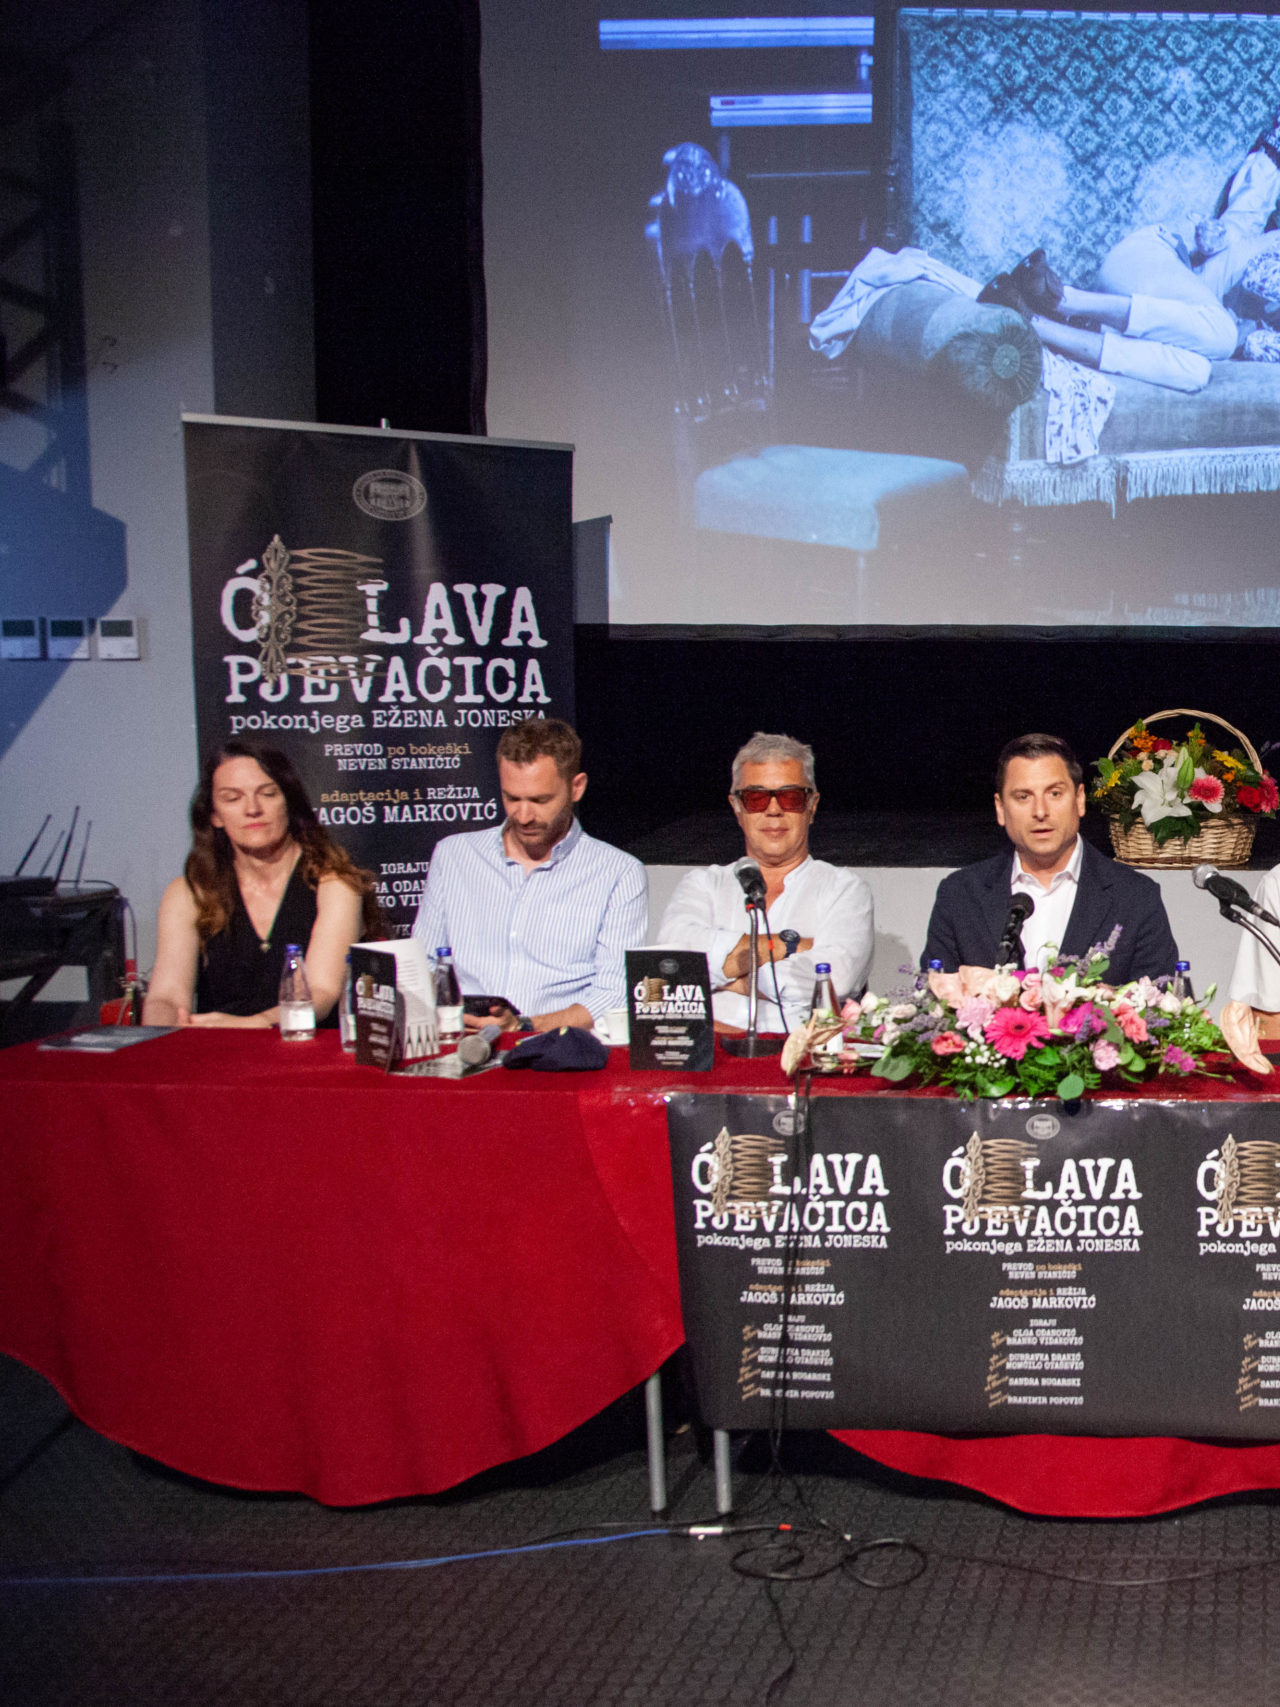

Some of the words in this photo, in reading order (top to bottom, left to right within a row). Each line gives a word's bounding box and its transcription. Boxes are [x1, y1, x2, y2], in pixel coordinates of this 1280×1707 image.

[223, 647, 551, 702] PJEVAČICA
[230, 710, 365, 733] pokonjega
[372, 705, 448, 728] EŽENA
[324, 744, 383, 756] PREVOD
[387, 746, 406, 758] po
[409, 743, 472, 755] bokeški
[337, 758, 387, 771] NEVEN
[391, 755, 461, 770] STANIČIĆ
[320, 789, 409, 803] adaptacija
[413, 789, 422, 800] i
[426, 785, 480, 800] REŽIJA
[314, 802, 376, 825] AGOŠ
[383, 798, 498, 823] MARKOVIĆ
[380, 862, 430, 875] IGRAJU
[693, 1193, 891, 1233] PJEVAČICA
[943, 1199, 1143, 1236] PJEVAČICA
[697, 1233, 771, 1250] pokonjega
[825, 1234, 888, 1248] JONESKA
[945, 1239, 1022, 1255] pokonjega
[1027, 1237, 1073, 1252] EŽENA
[1076, 1238, 1140, 1252] JONESKA
[1199, 1240, 1277, 1256] pokonjega
[1002, 1262, 1034, 1271] PREVOD
[740, 1290, 778, 1304] JAGOŠ
[781, 1291, 845, 1305] ARKOVIĆ
[989, 1296, 1029, 1309] JAGOŠ
[1032, 1294, 1096, 1309] MARKOVIĆ
